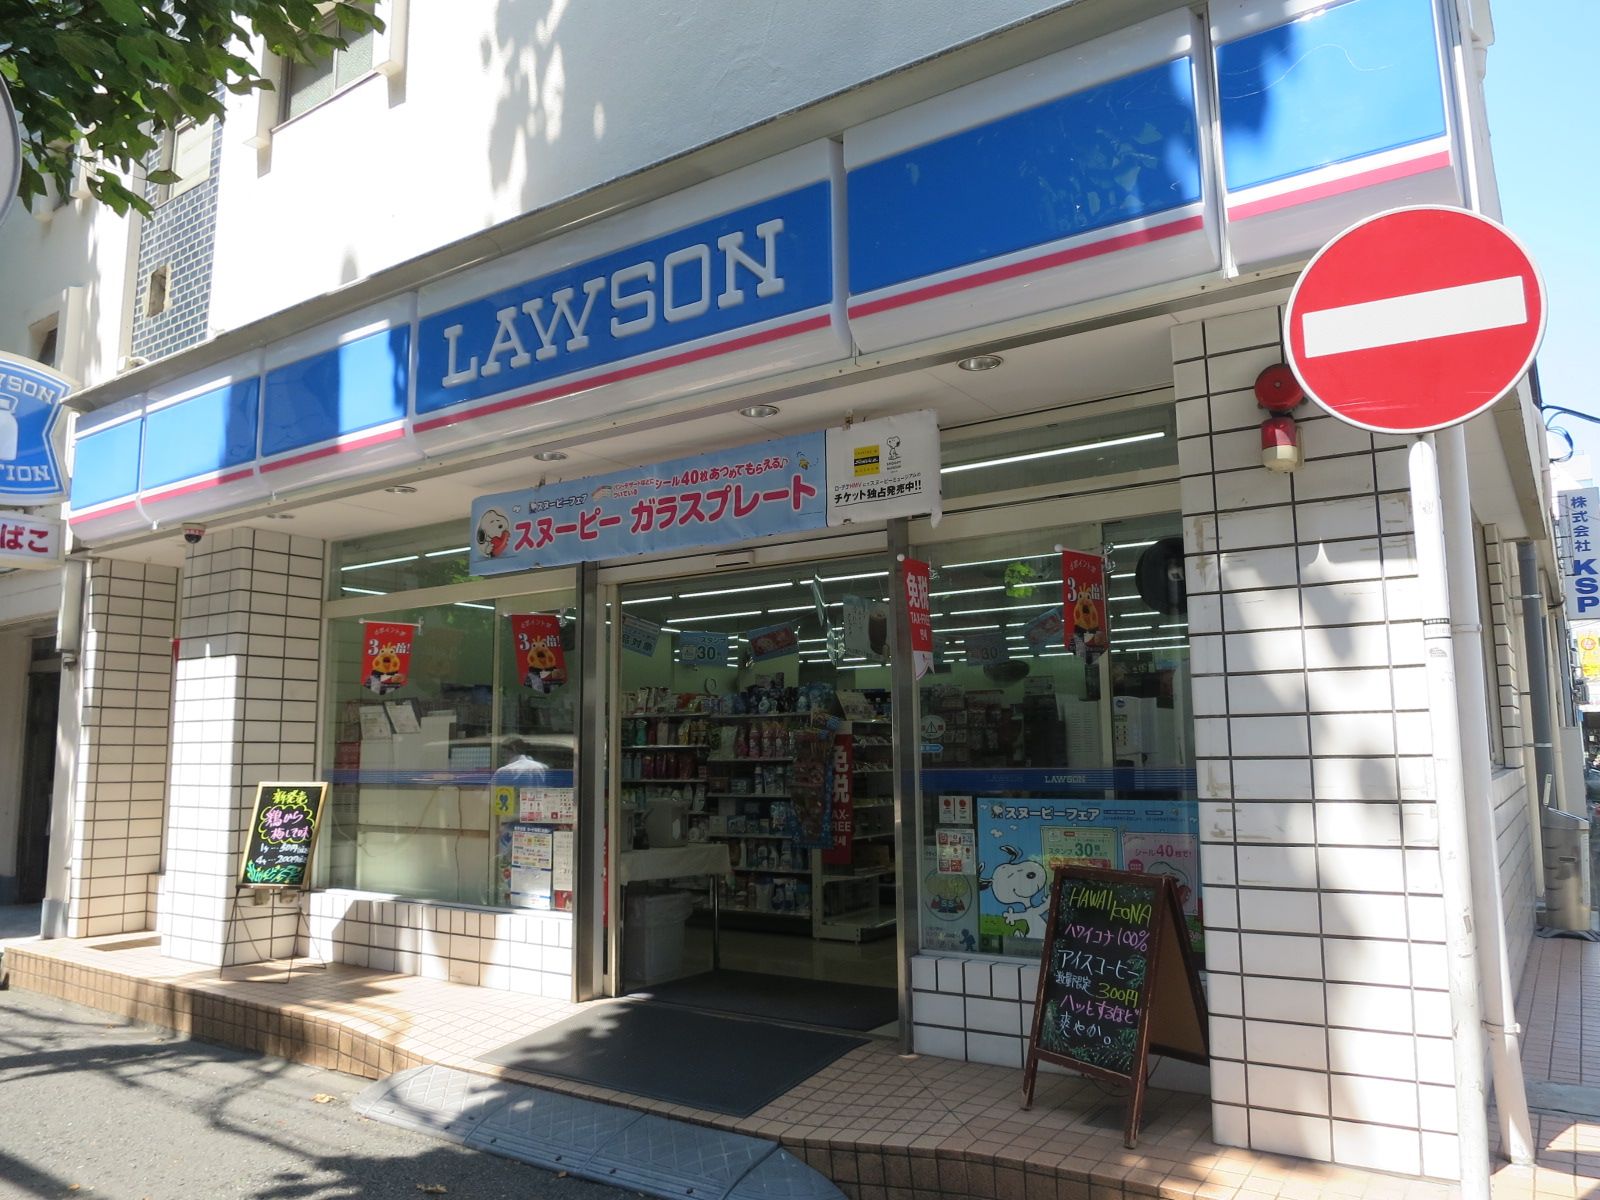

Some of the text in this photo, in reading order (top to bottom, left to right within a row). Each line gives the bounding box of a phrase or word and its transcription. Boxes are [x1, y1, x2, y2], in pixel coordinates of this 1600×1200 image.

[442, 218, 784, 388] LAWSON
[514, 474, 816, 551] スヌーピー ガラスプレート
[1571, 496, 1592, 552] 株式会社
[1573, 558, 1600, 613] KSP
[1004, 806, 1100, 821] スヌーピーフェア
[1064, 922, 1151, 952] ハワイコナ 100%
[1057, 949, 1141, 980] アイスコーヒー
[1059, 994, 1143, 1024] ハッとするほど
